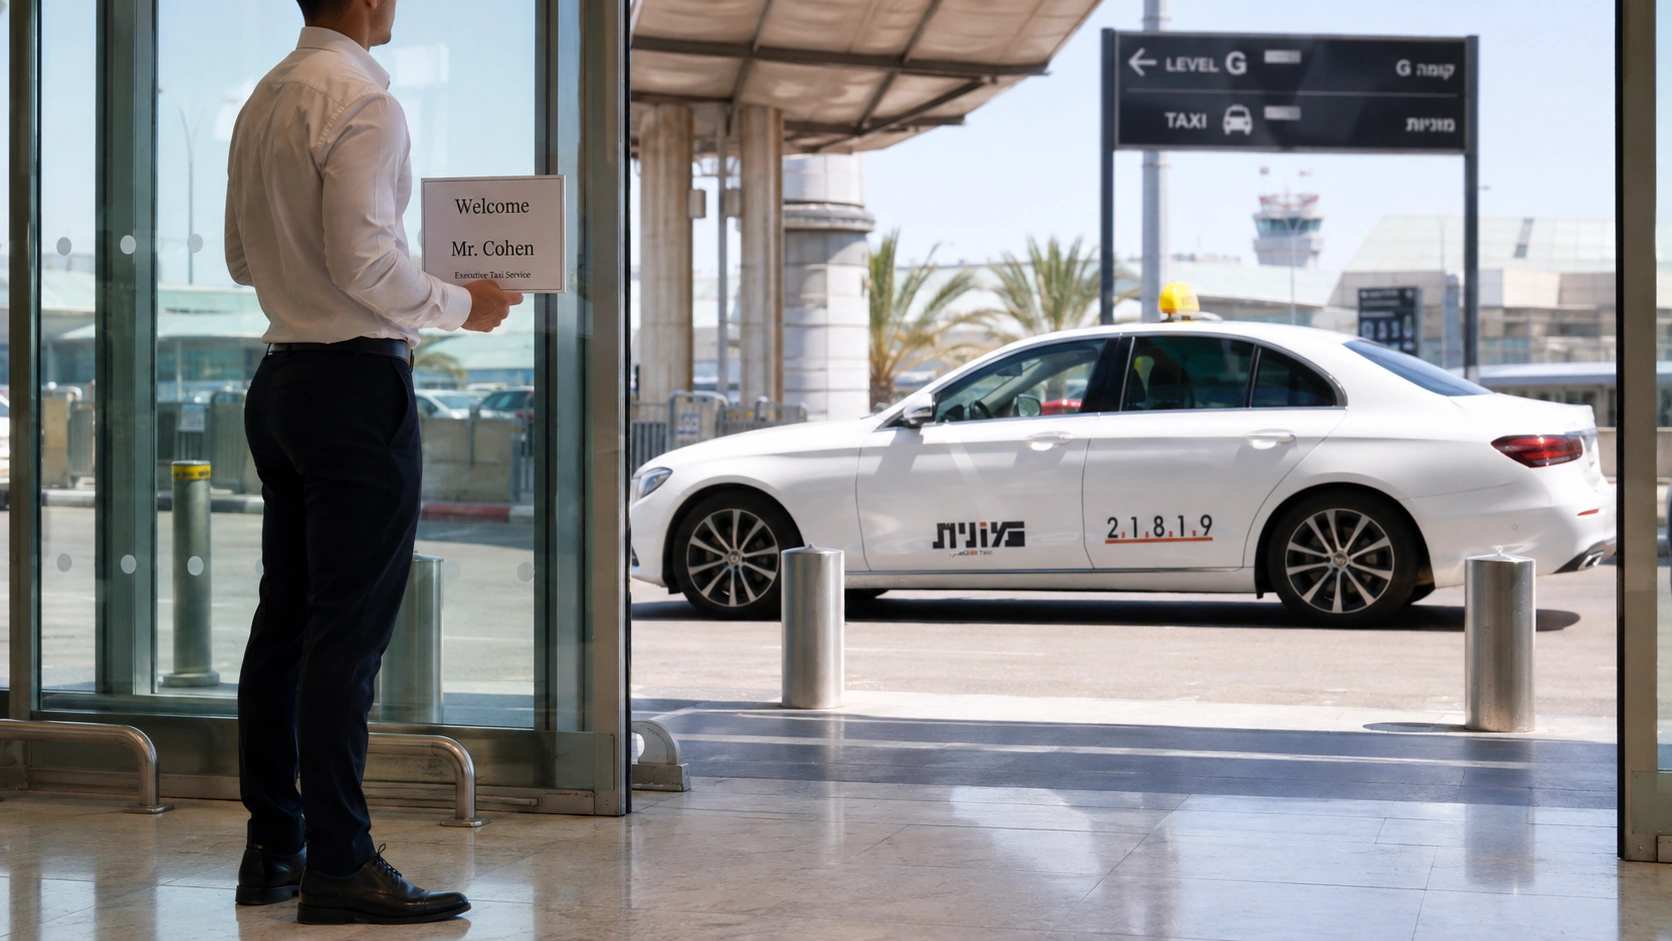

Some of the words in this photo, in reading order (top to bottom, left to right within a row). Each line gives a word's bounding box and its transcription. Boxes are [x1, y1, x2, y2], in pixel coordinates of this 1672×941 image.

[1165, 57, 1219, 73] LEVEL
[1225, 51, 1247, 75] G
[1396, 59, 1412, 77] G
[1416, 63, 1456, 80] קומה
[1165, 112, 1208, 129] TAXI
[1405, 117, 1456, 133] מוניות
[454, 198, 530, 214] Welcome
[451, 241, 478, 256] Mr.
[483, 240, 535, 256] Cohen
[454, 271, 488, 279] Executive
[489, 271, 504, 279] Taxi
[505, 271, 532, 279] Service
